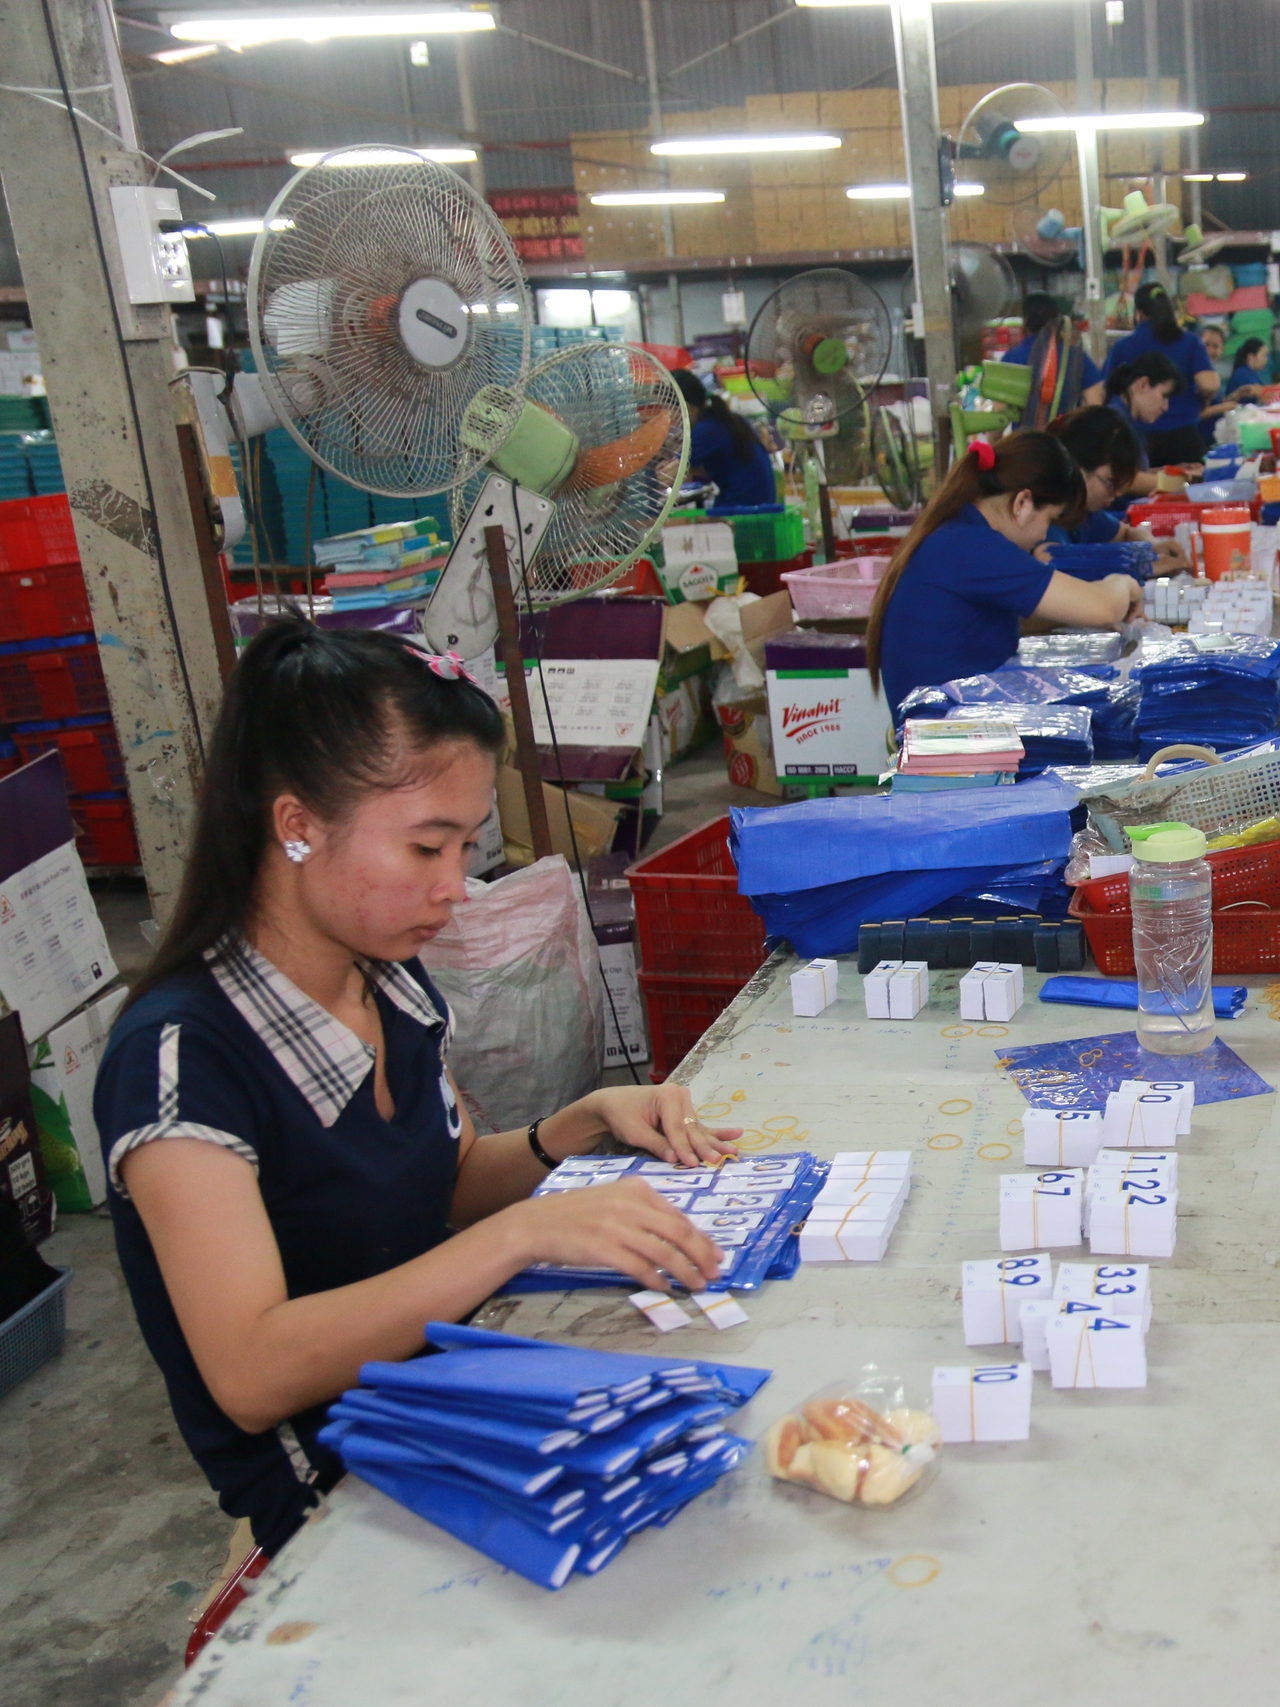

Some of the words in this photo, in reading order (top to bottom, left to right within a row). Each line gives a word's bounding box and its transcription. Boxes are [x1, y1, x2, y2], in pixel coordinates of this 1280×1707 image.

[782, 698, 847, 728] Vinamit
[1055, 1111, 1092, 1121] 5
[1037, 1172, 1076, 1184] 6
[1122, 1179, 1161, 1190] 2
[1128, 1194, 1168, 1205] 2
[997, 1258, 1040, 1270] 8
[1096, 1266, 1138, 1279] 3
[998, 1273, 1041, 1286] 9
[1095, 1283, 1137, 1295] 3
[1060, 1301, 1103, 1314] 4
[1087, 1317, 1132, 1331] 4
[972, 1363, 1019, 1383] 10
